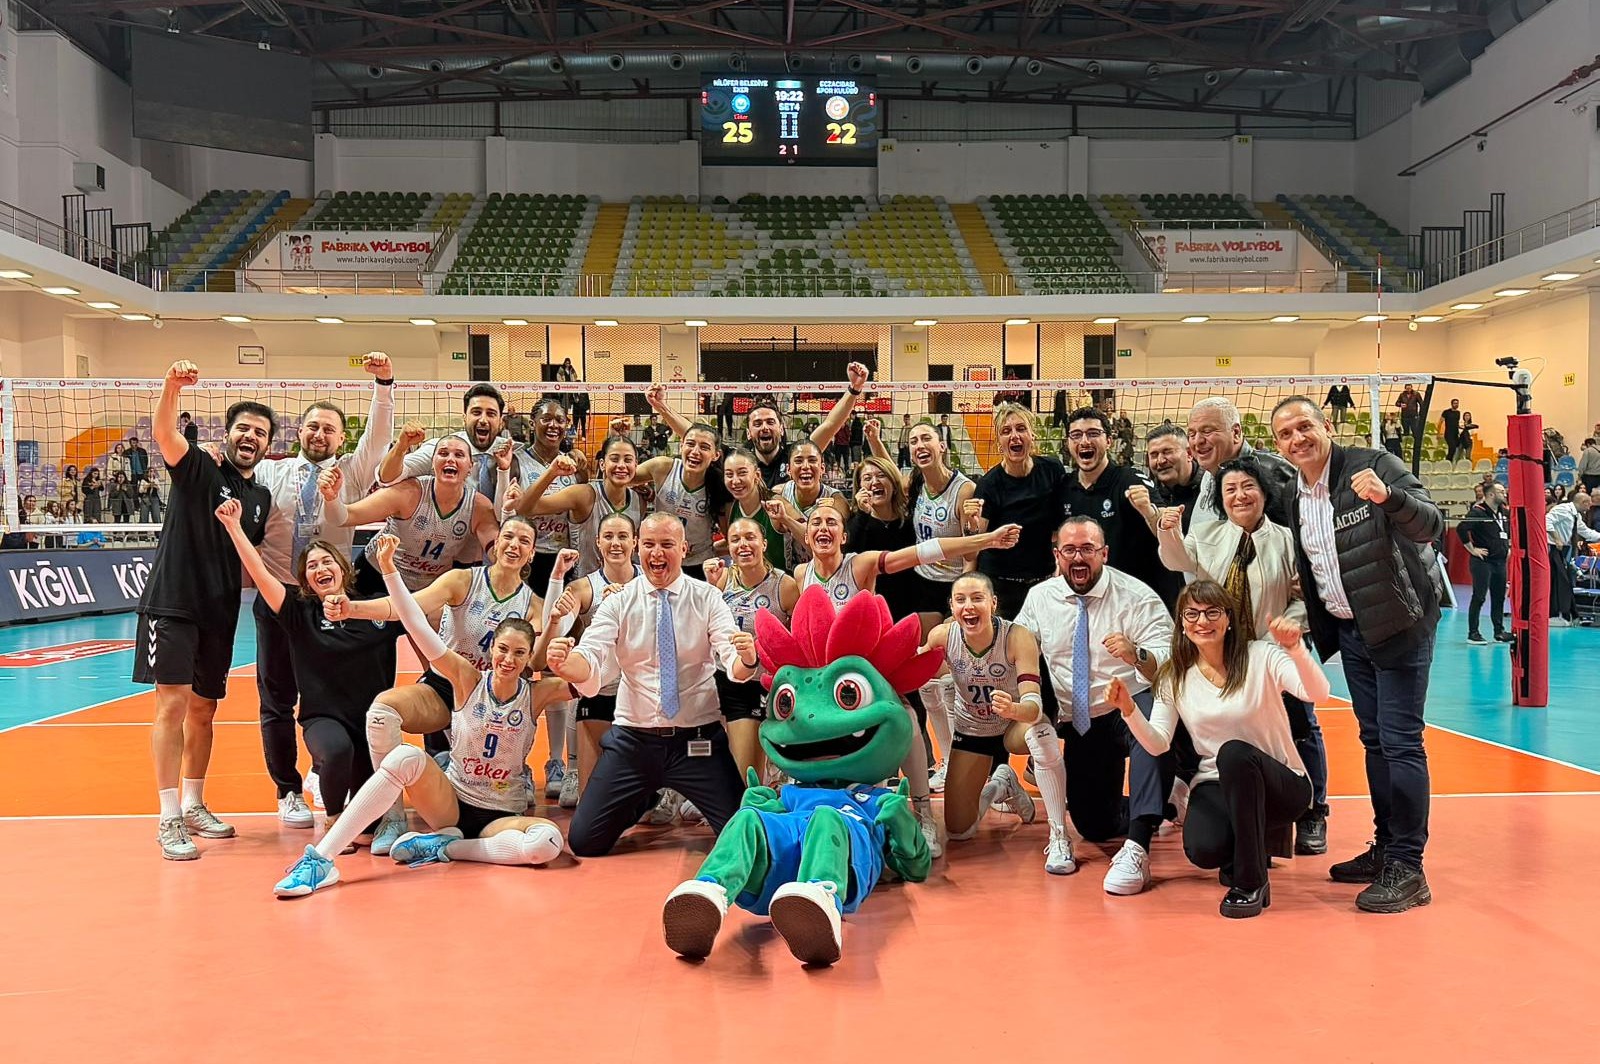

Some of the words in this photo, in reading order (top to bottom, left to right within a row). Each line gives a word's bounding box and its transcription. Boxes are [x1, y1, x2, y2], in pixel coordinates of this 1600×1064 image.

[775, 91, 804, 102] 19:22
[722, 122, 753, 144] 25
[826, 123, 856, 144] 22
[778, 145, 787, 155] 2
[792, 145, 798, 155] 1
[1222, 240, 1283, 252] VOLEYBOL
[336, 256, 420, 264] www.fabrikavoleybol.com
[1189, 256, 1269, 264] www.fabrikavoleybol.com
[420, 540, 446, 560] 14
[478, 630, 494, 652] 4
[482, 733, 499, 758] 9
